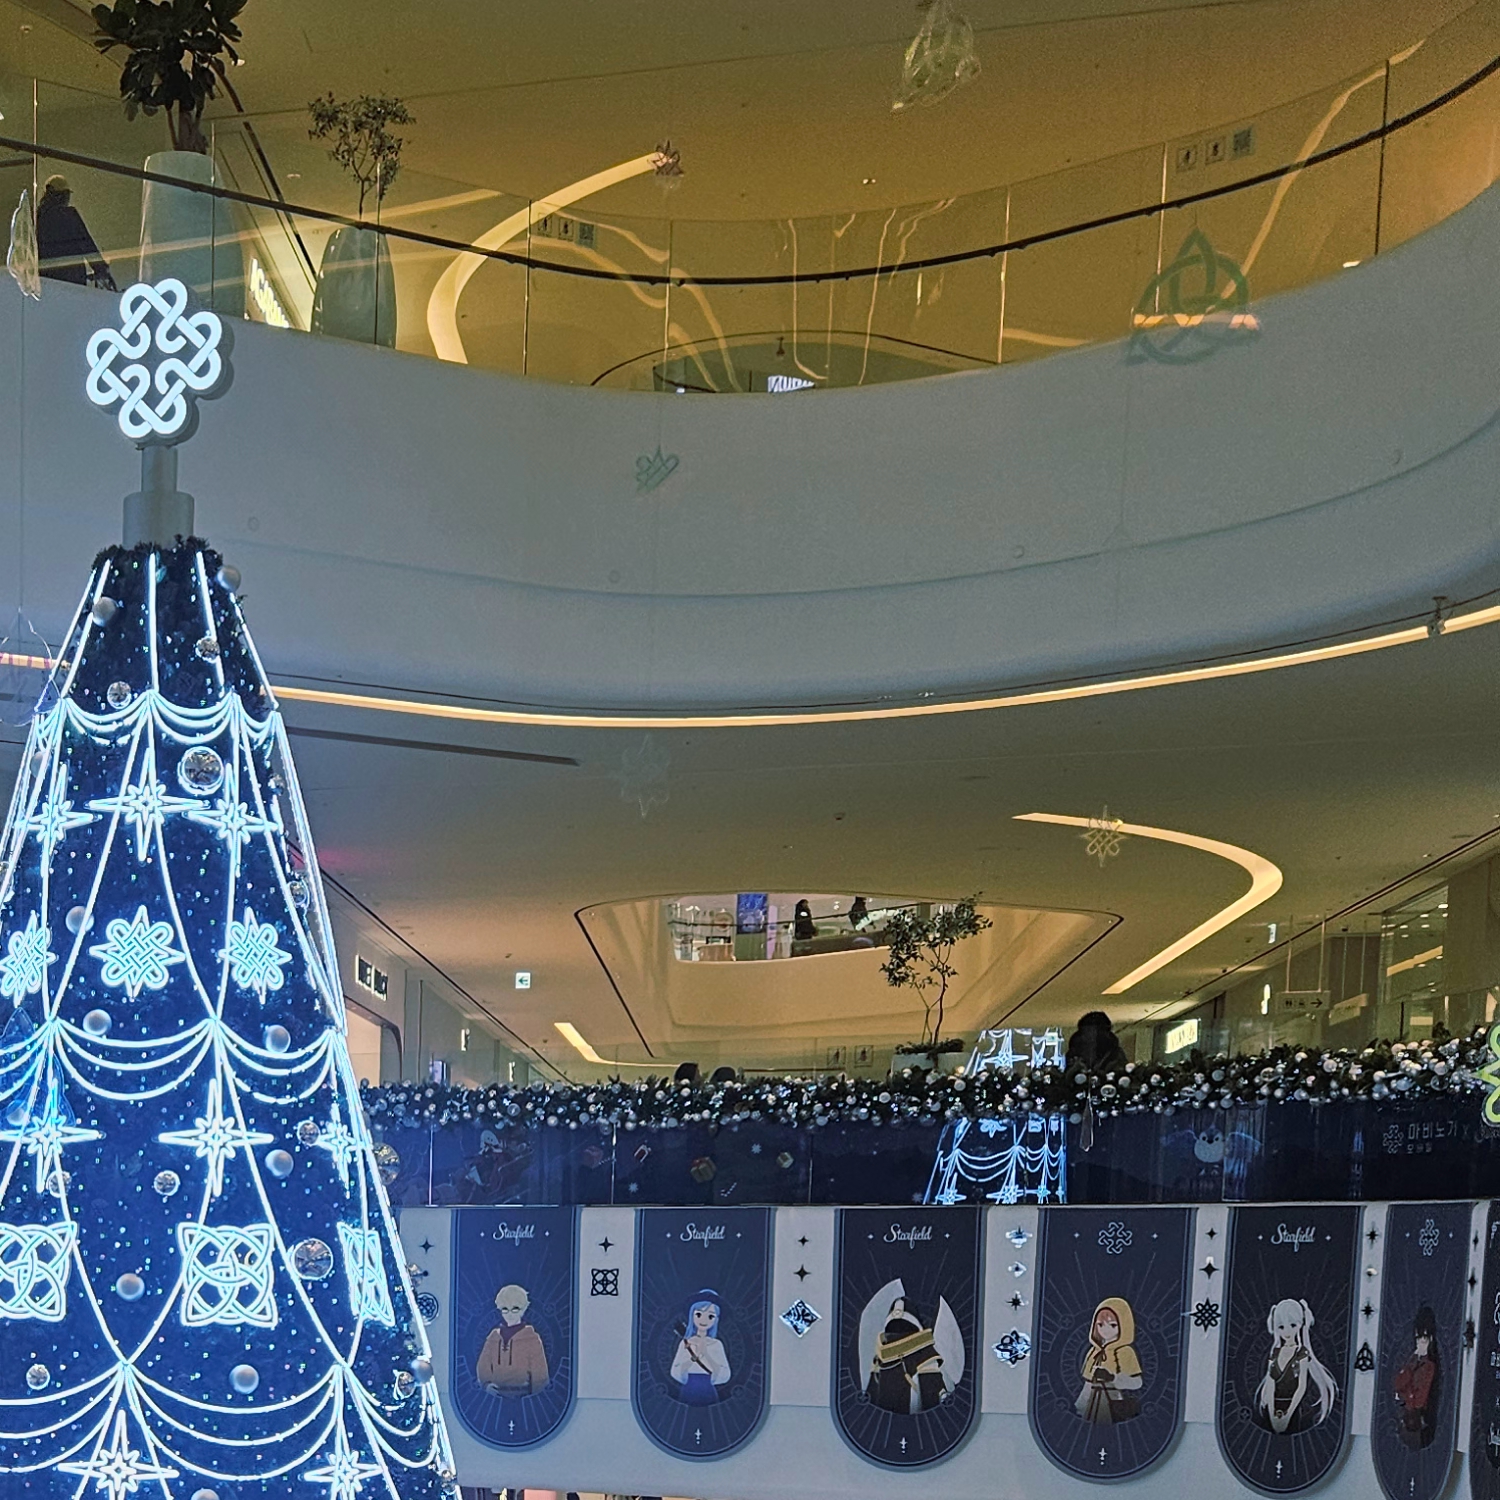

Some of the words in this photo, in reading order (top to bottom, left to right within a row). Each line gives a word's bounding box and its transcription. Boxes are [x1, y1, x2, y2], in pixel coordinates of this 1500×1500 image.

[1407, 1121, 1458, 1140] 마비노기
[492, 1221, 535, 1246] Starfield
[680, 1222, 726, 1248] Starfield
[883, 1223, 932, 1249] Starfield
[1271, 1223, 1317, 1252] Starfield
